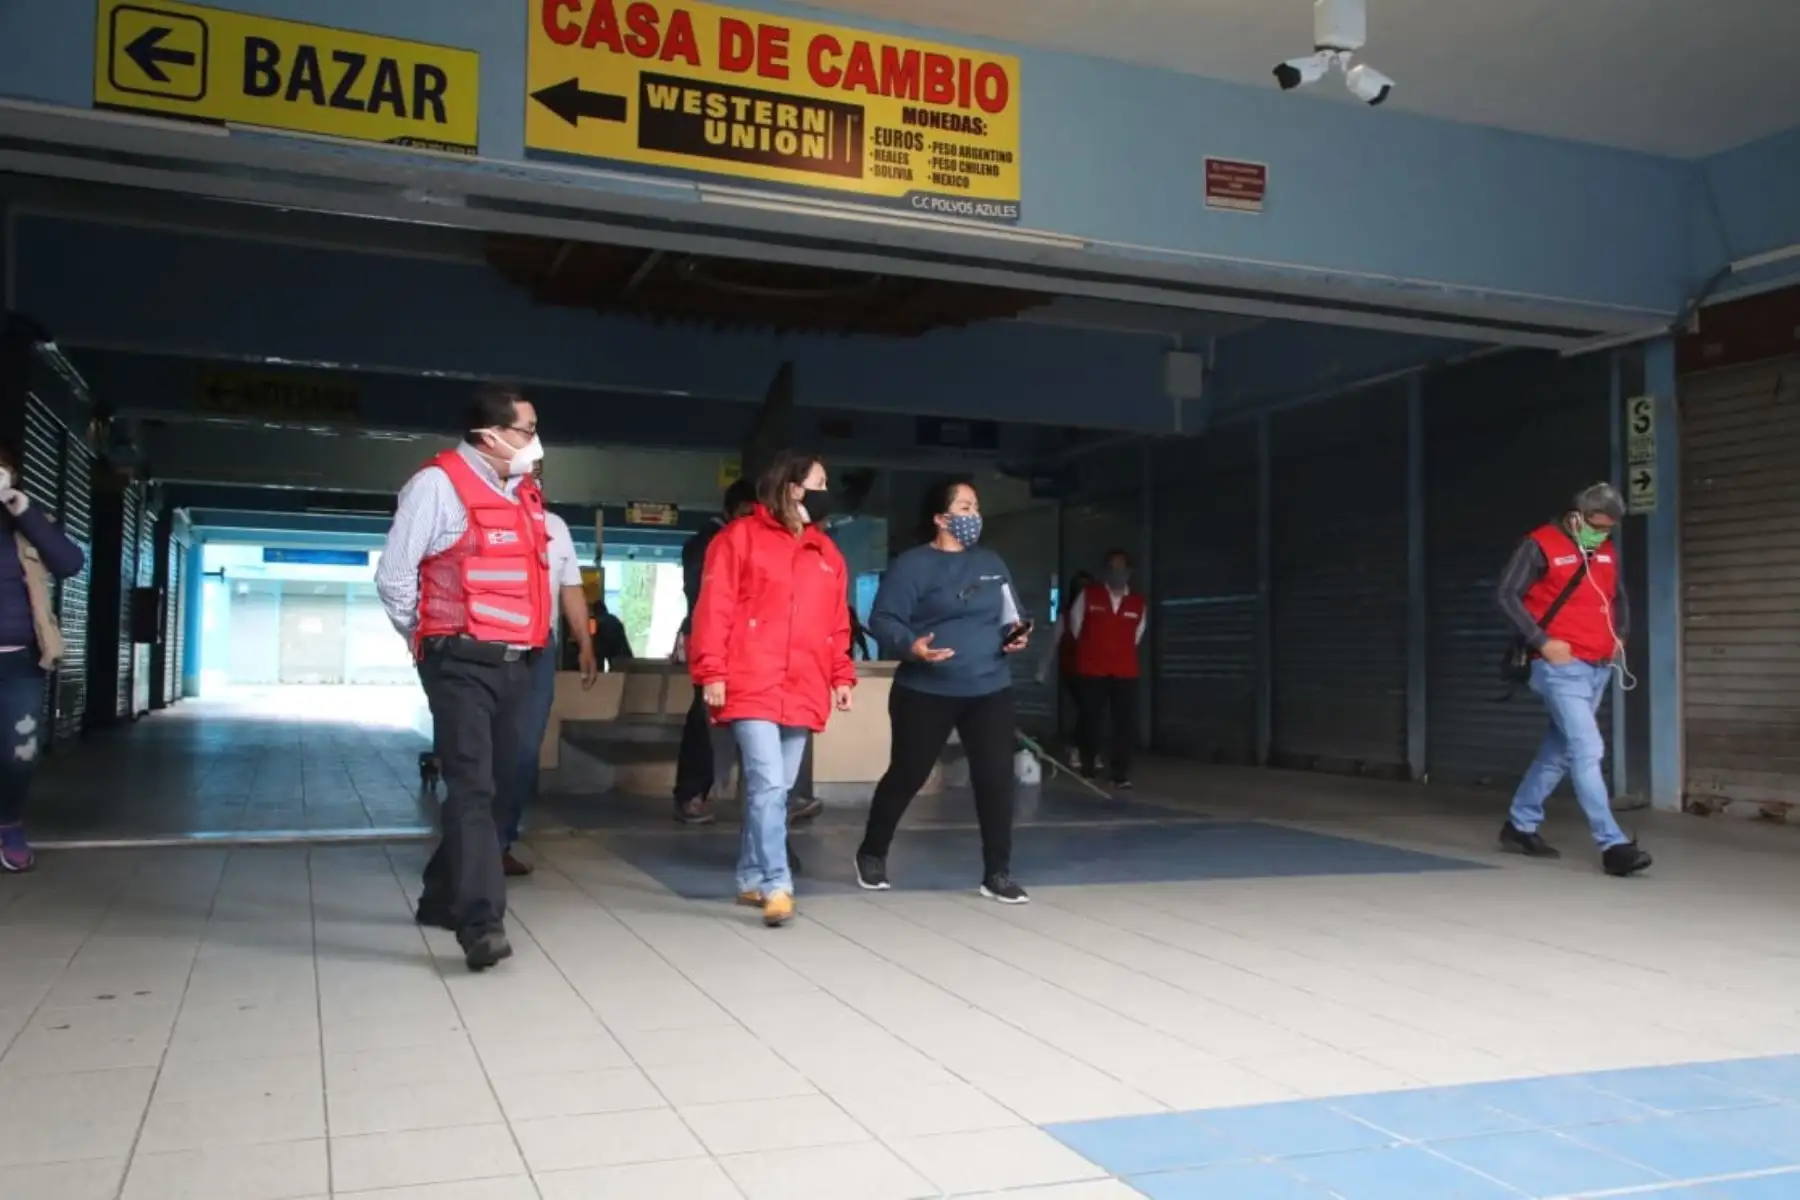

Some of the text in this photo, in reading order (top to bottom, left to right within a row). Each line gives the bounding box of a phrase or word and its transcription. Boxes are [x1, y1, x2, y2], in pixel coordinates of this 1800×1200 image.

[542, 0, 1009, 113] CASA DE CAMBIO
[243, 36, 447, 123] BAZAR
[646, 83, 825, 133] WESTERN
[902, 106, 988, 136] MONEDAS:
[704, 119, 825, 159] UNION
[931, 198, 973, 213] POLVOS
[975, 203, 1017, 217] AZULES
[1634, 401, 1651, 433] S
